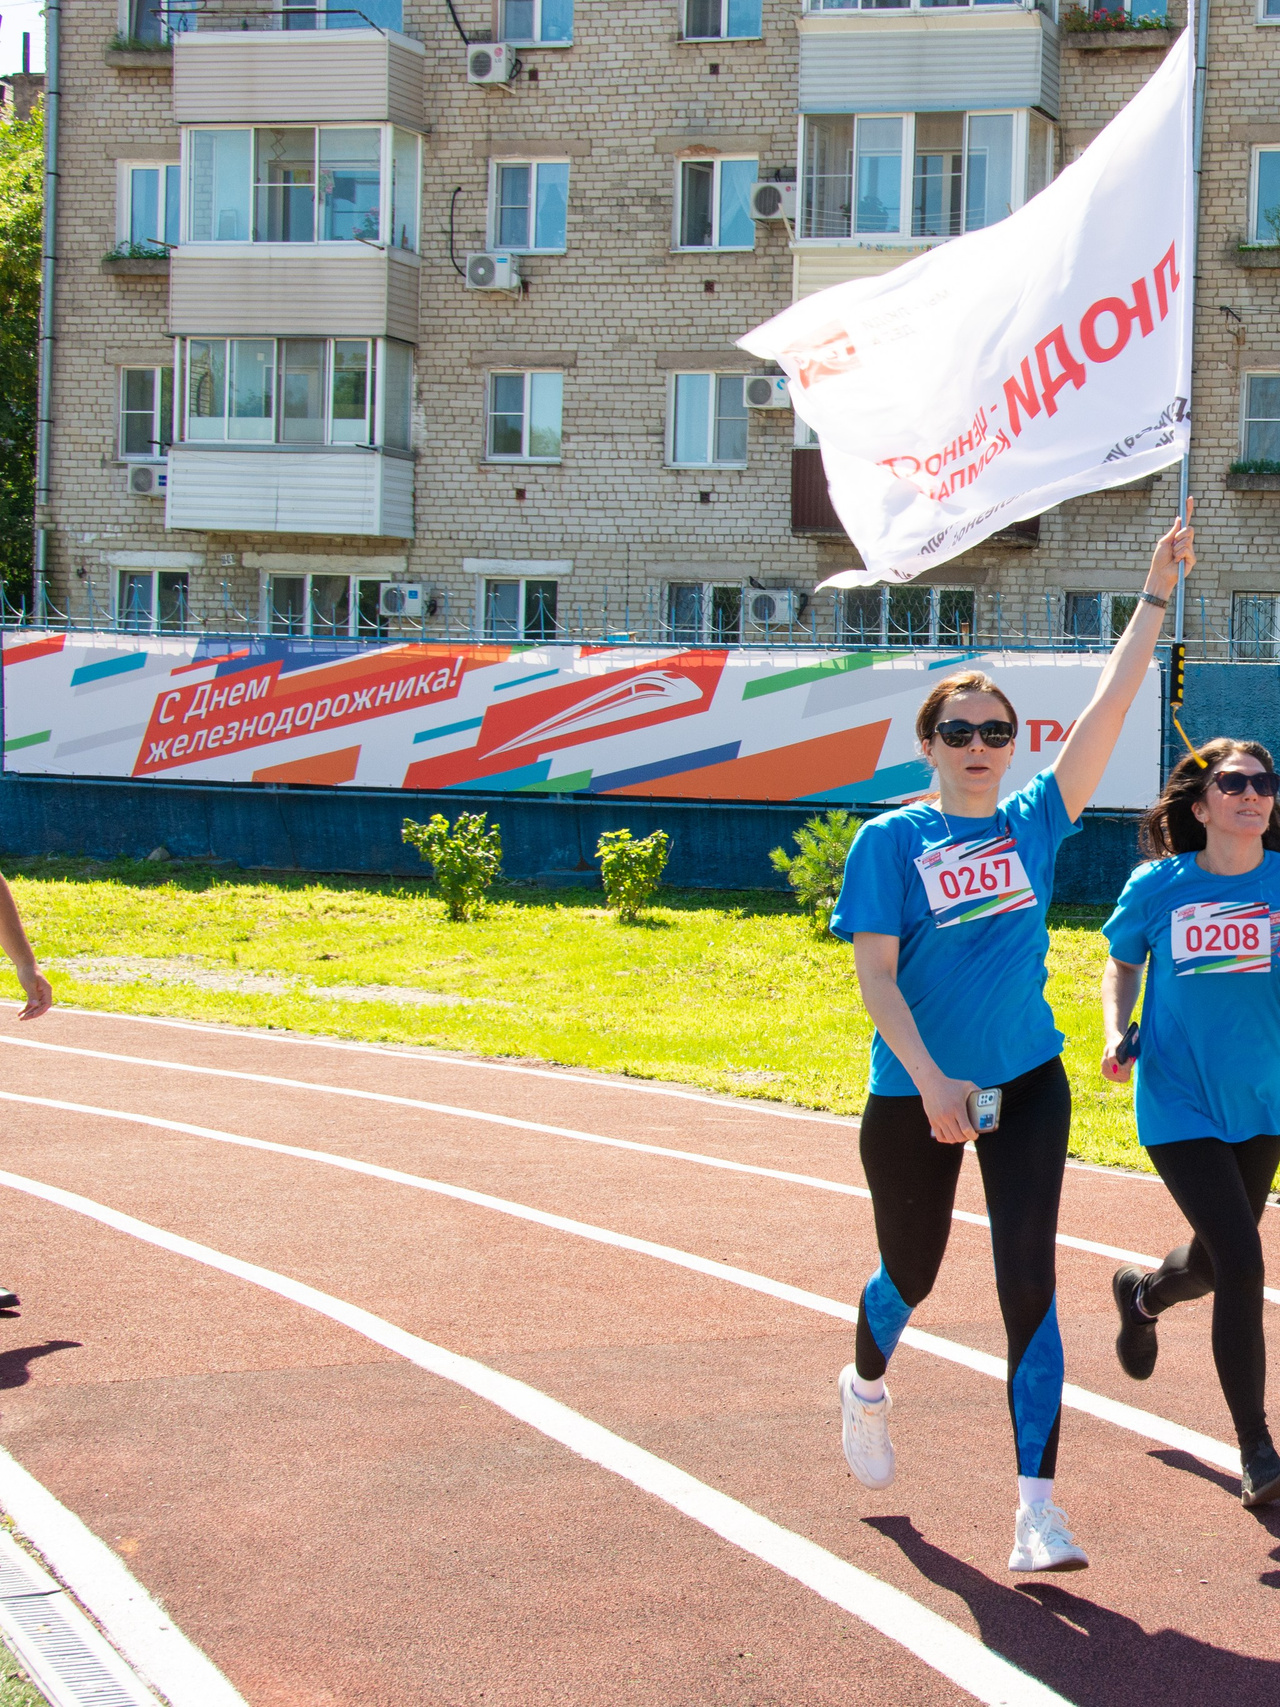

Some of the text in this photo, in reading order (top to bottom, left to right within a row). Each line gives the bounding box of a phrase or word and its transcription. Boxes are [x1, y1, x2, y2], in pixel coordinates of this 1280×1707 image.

[144, 656, 465, 765] железнодорожника!
[158, 675, 273, 725] С Днем
[938, 858, 1011, 900] 0267
[1185, 923, 1260, 953] 0208
